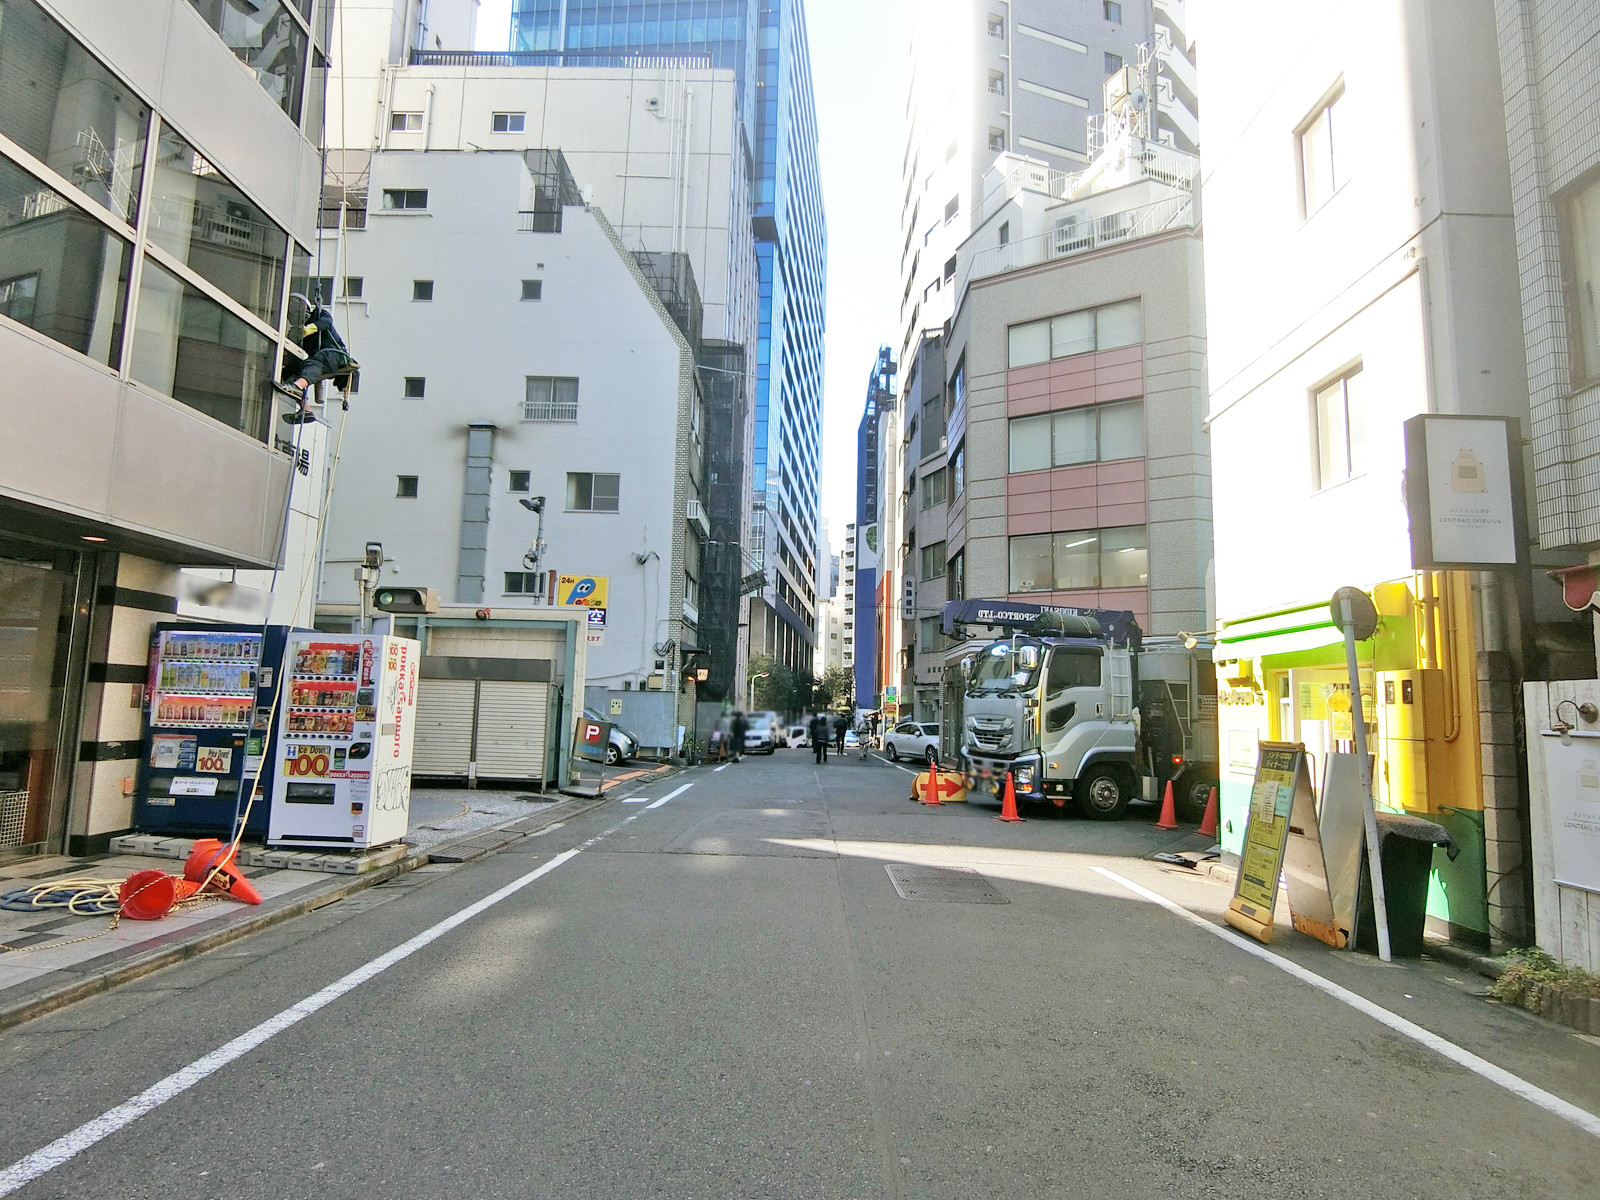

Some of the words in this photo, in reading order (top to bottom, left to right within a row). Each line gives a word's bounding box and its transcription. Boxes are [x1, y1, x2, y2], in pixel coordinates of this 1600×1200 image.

[588, 608, 605, 625] 空
[585, 724, 600, 740] P
[199, 757, 224, 770] 100
